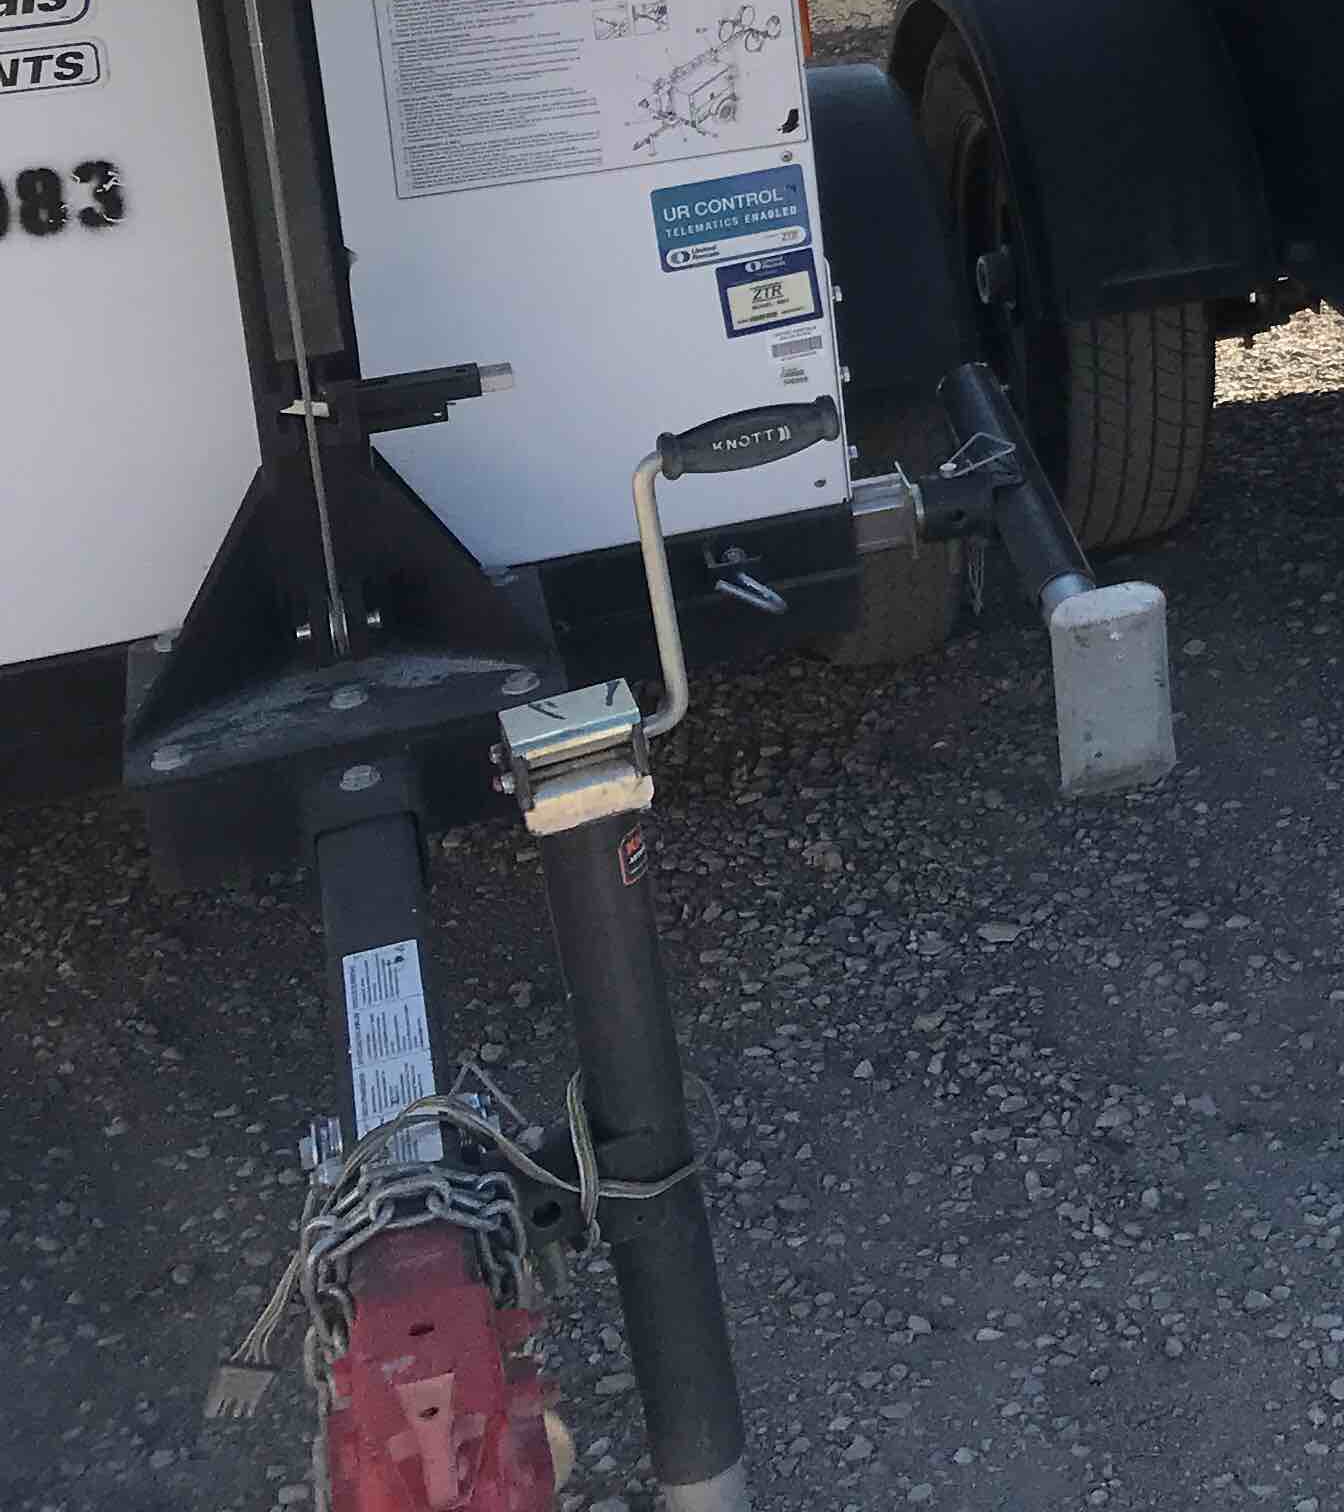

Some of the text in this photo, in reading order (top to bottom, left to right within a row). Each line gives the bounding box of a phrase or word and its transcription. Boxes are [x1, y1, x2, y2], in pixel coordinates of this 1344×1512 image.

[662, 188, 784, 222] UR CONTROL
[665, 205, 799, 239] TELEMATICS ENABLED
[752, 284, 784, 304] ZTR
[711, 427, 775, 451] KNOTT
